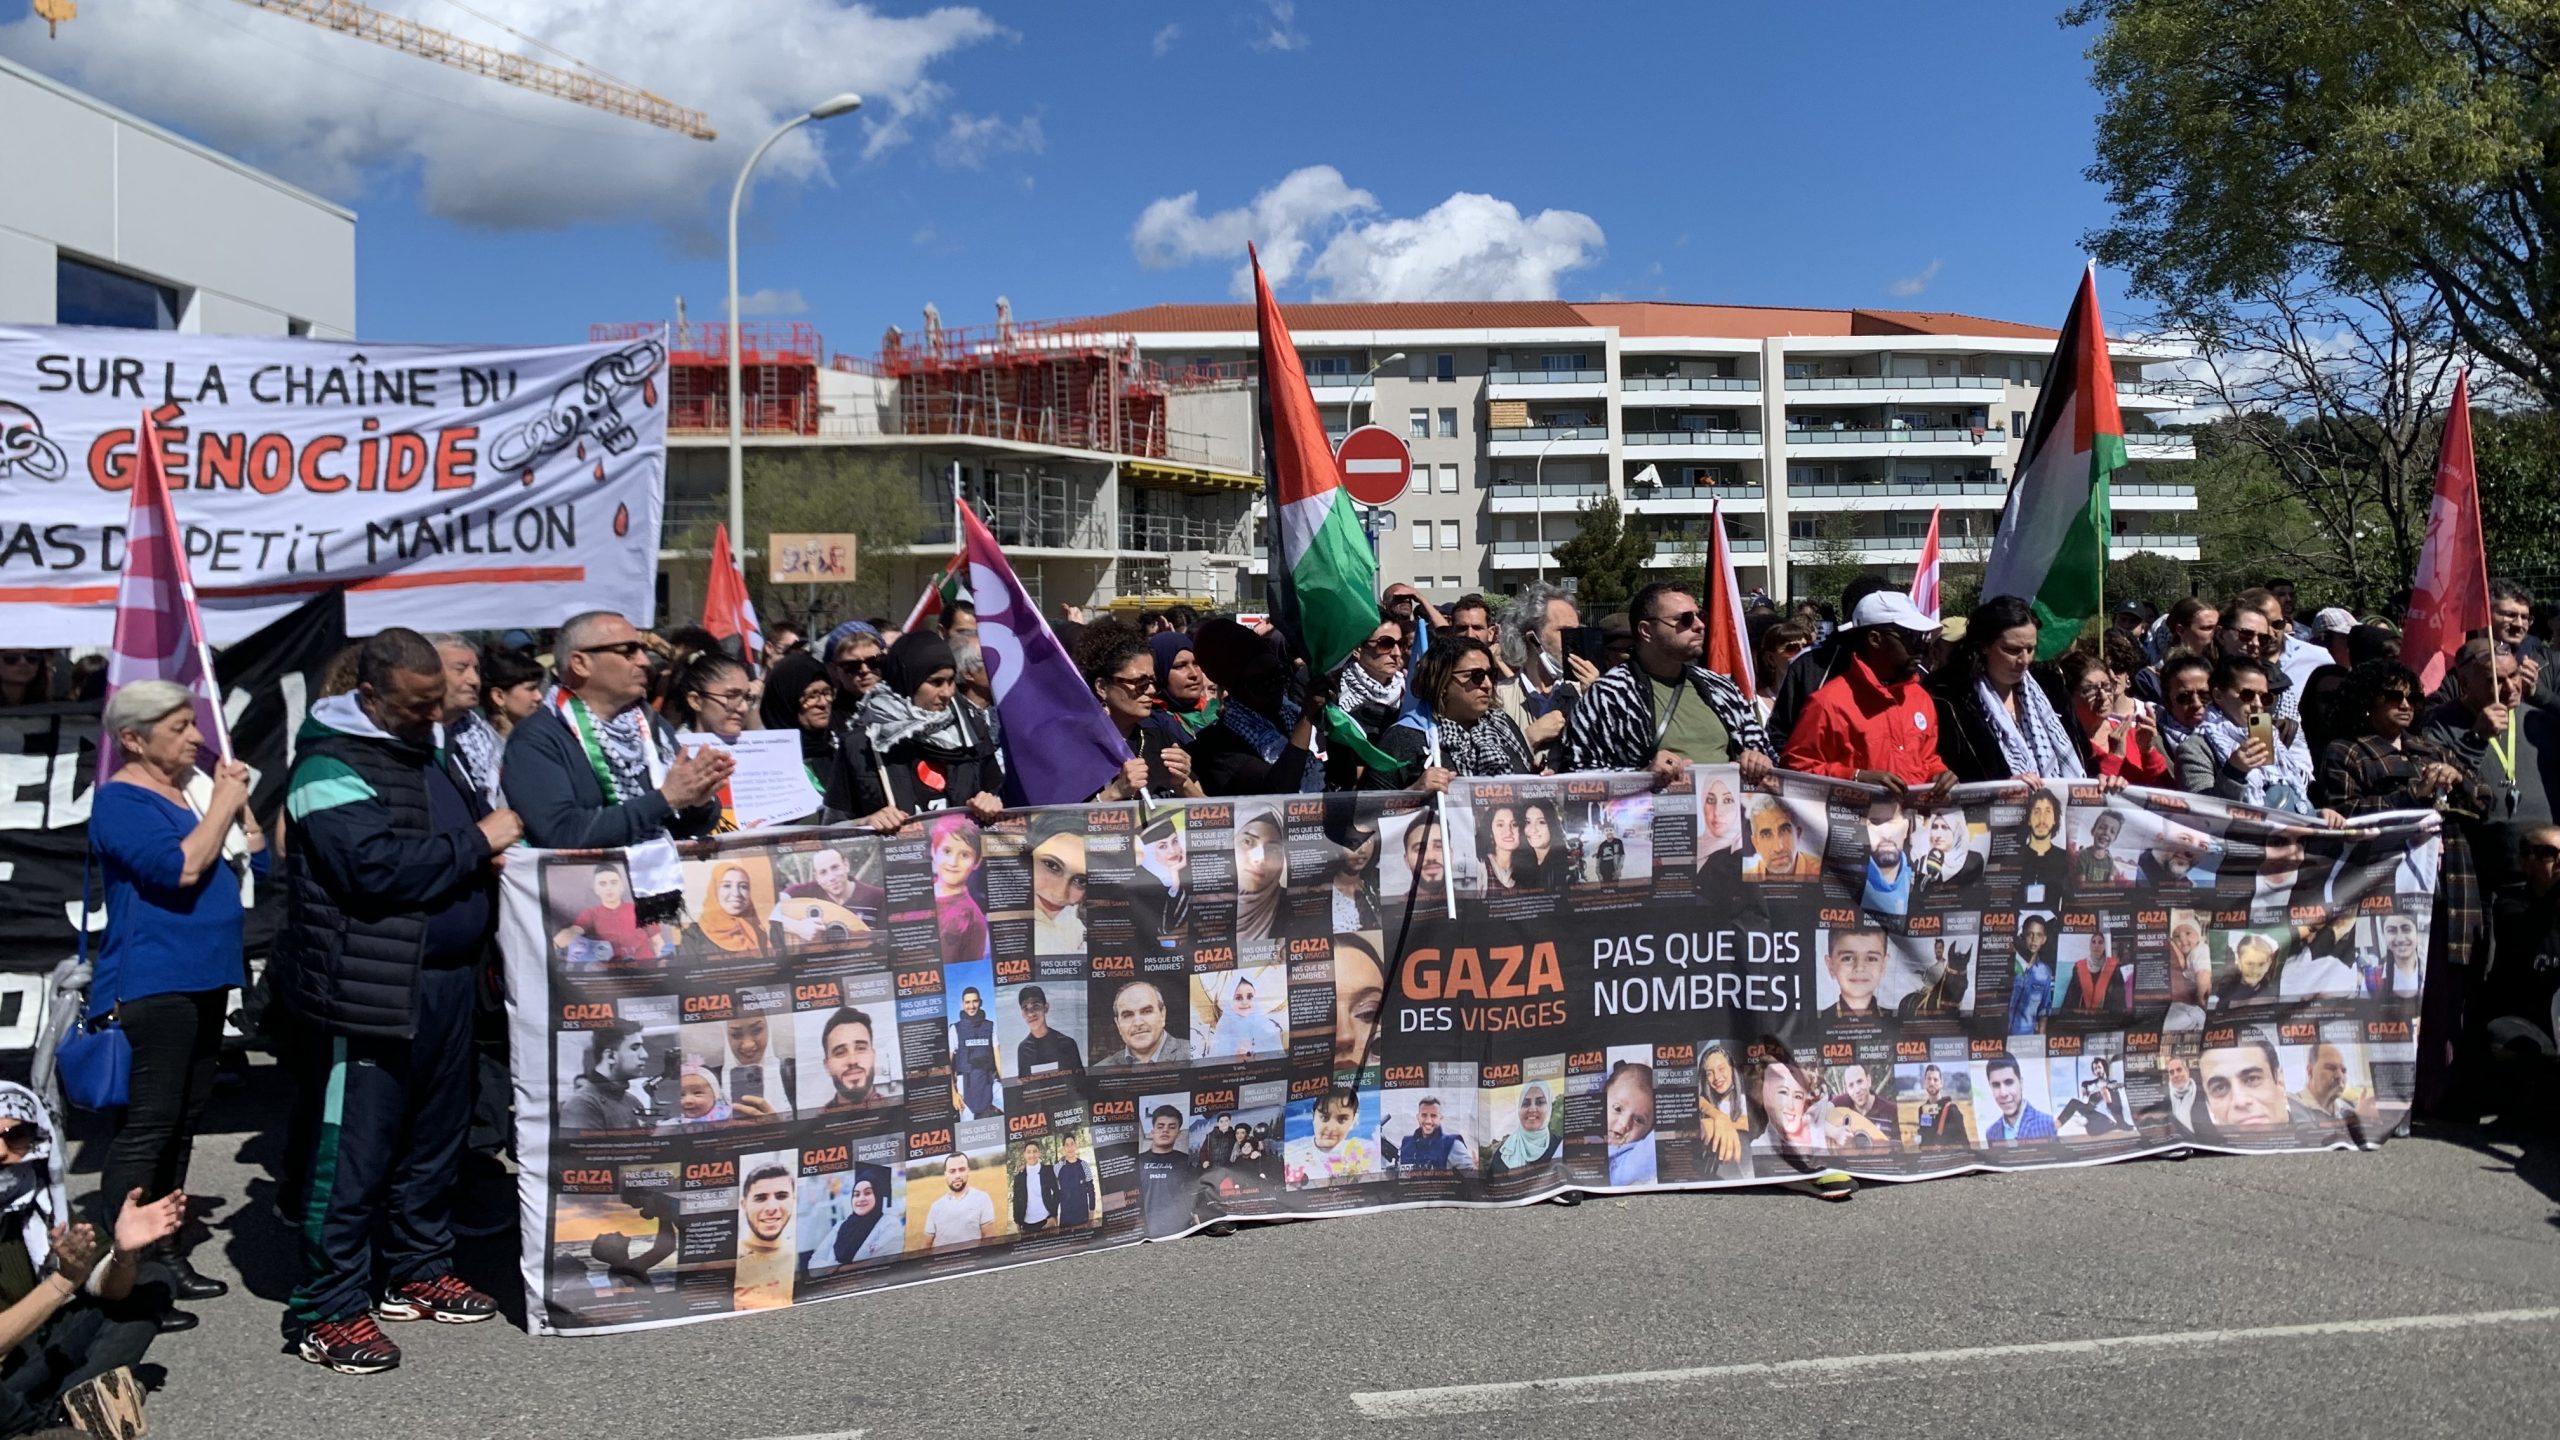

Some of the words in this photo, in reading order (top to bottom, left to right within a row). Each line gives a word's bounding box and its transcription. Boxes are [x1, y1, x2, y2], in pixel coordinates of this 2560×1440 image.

[37, 354, 144, 398] SUR
[164, 361, 228, 405] LA
[250, 354, 437, 406] CHAÎNE
[461, 366, 516, 407] DU
[0, 522, 86, 570] AS
[1475, 785, 1513, 796] GAZA
[1569, 783, 1604, 793] GAZA
[1088, 810, 1129, 824] GAZA
[1189, 806, 1230, 820] GAZA
[1088, 824, 1101, 832] DES
[1820, 909, 1854, 921] GAZA
[2137, 911, 2168, 922] GAZA
[2290, 906, 2326, 918] GAZA
[1910, 917, 1939, 929] GAZA
[1984, 913, 2015, 926] GAZA
[2064, 914, 2096, 926] GAZA
[1291, 938, 1329, 951] GAZA
[1593, 935, 1655, 970] PAS
[1665, 931, 1736, 969] QUE
[1748, 931, 1800, 964] DES
[1194, 947, 1232, 962] GAZA
[1291, 952, 1302, 960] DES
[996, 960, 1030, 975] GAZA
[1092, 956, 1134, 969] GAZA
[1194, 964, 1206, 972] DES
[1092, 970, 1105, 978] DES
[1402, 942, 1565, 1000] GAZA
[898, 970, 940, 988] GAZA
[796, 982, 839, 1000] GAZA
[898, 988, 911, 996] DES
[685, 994, 732, 1012] GAZA
[563, 1004, 614, 1019] GAZA
[1401, 1006, 1452, 1032] DES
[1462, 1001, 1567, 1032] VISAGES
[2282, 1024, 2316, 1037] GAZA
[2369, 1022, 2408, 1034] GAZA
[2128, 1033, 2158, 1045] GAZA
[2206, 1029, 2234, 1041] GAZA
[1897, 1042, 1926, 1054] GAZA
[1972, 1040, 2002, 1051] GAZA
[2050, 1038, 2080, 1048] GAZA
[1657, 1046, 1693, 1058] GAZA
[1824, 1044, 1852, 1057] GAZA
[1569, 1052, 1603, 1066] GAZA
[1385, 1067, 1424, 1079] GAZA
[1483, 1064, 1520, 1078] GAZA
[1292, 1077, 1328, 1092] GAZA
[1195, 1091, 1234, 1104] GAZA
[1093, 1100, 1134, 1114] GAZA
[1009, 1112, 1047, 1131] GAZA
[910, 1129, 950, 1148] GAZA
[1010, 1132, 1022, 1140] DES
[803, 1146, 848, 1164] GAZA
[686, 1161, 734, 1178] GAZA
[803, 1166, 817, 1174] DES
[563, 1170, 612, 1184] GAZA
[686, 1180, 700, 1188] DES
